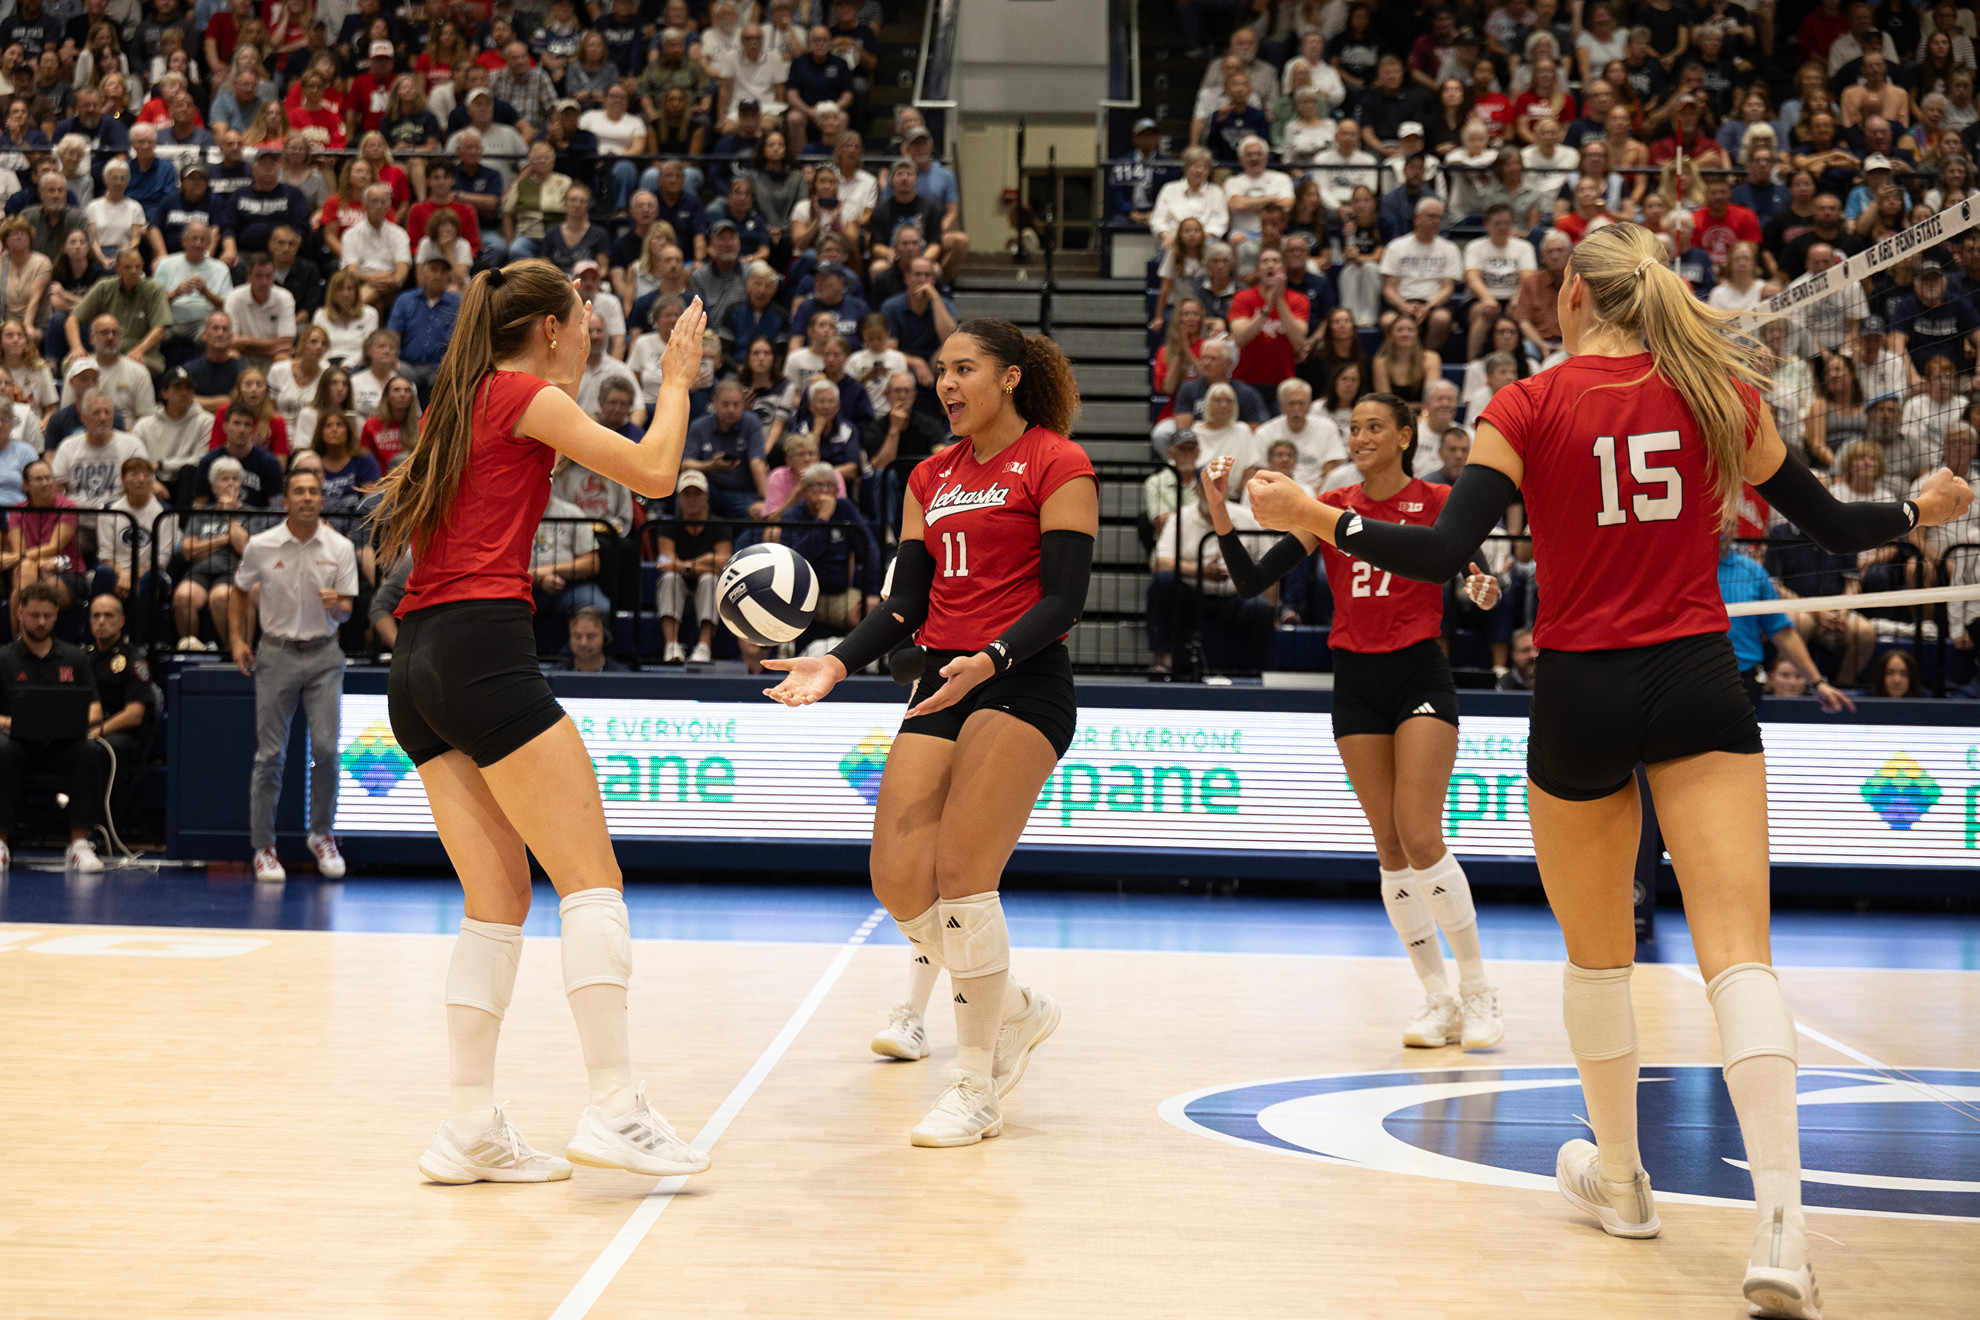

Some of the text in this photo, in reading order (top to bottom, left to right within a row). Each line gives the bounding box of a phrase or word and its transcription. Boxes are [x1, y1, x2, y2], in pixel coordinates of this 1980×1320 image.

[1878, 238, 1894, 263] ARE
[1894, 229, 1916, 256] PENN
[1916, 214, 1943, 244] STATE
[1592, 429, 1683, 527] 15
[925, 481, 1011, 516] Nebraska
[941, 531, 969, 578] 11
[1351, 560, 1392, 598] 27
[606, 716, 736, 743] EVERYONE
[1110, 727, 1242, 754] EVERYONE
